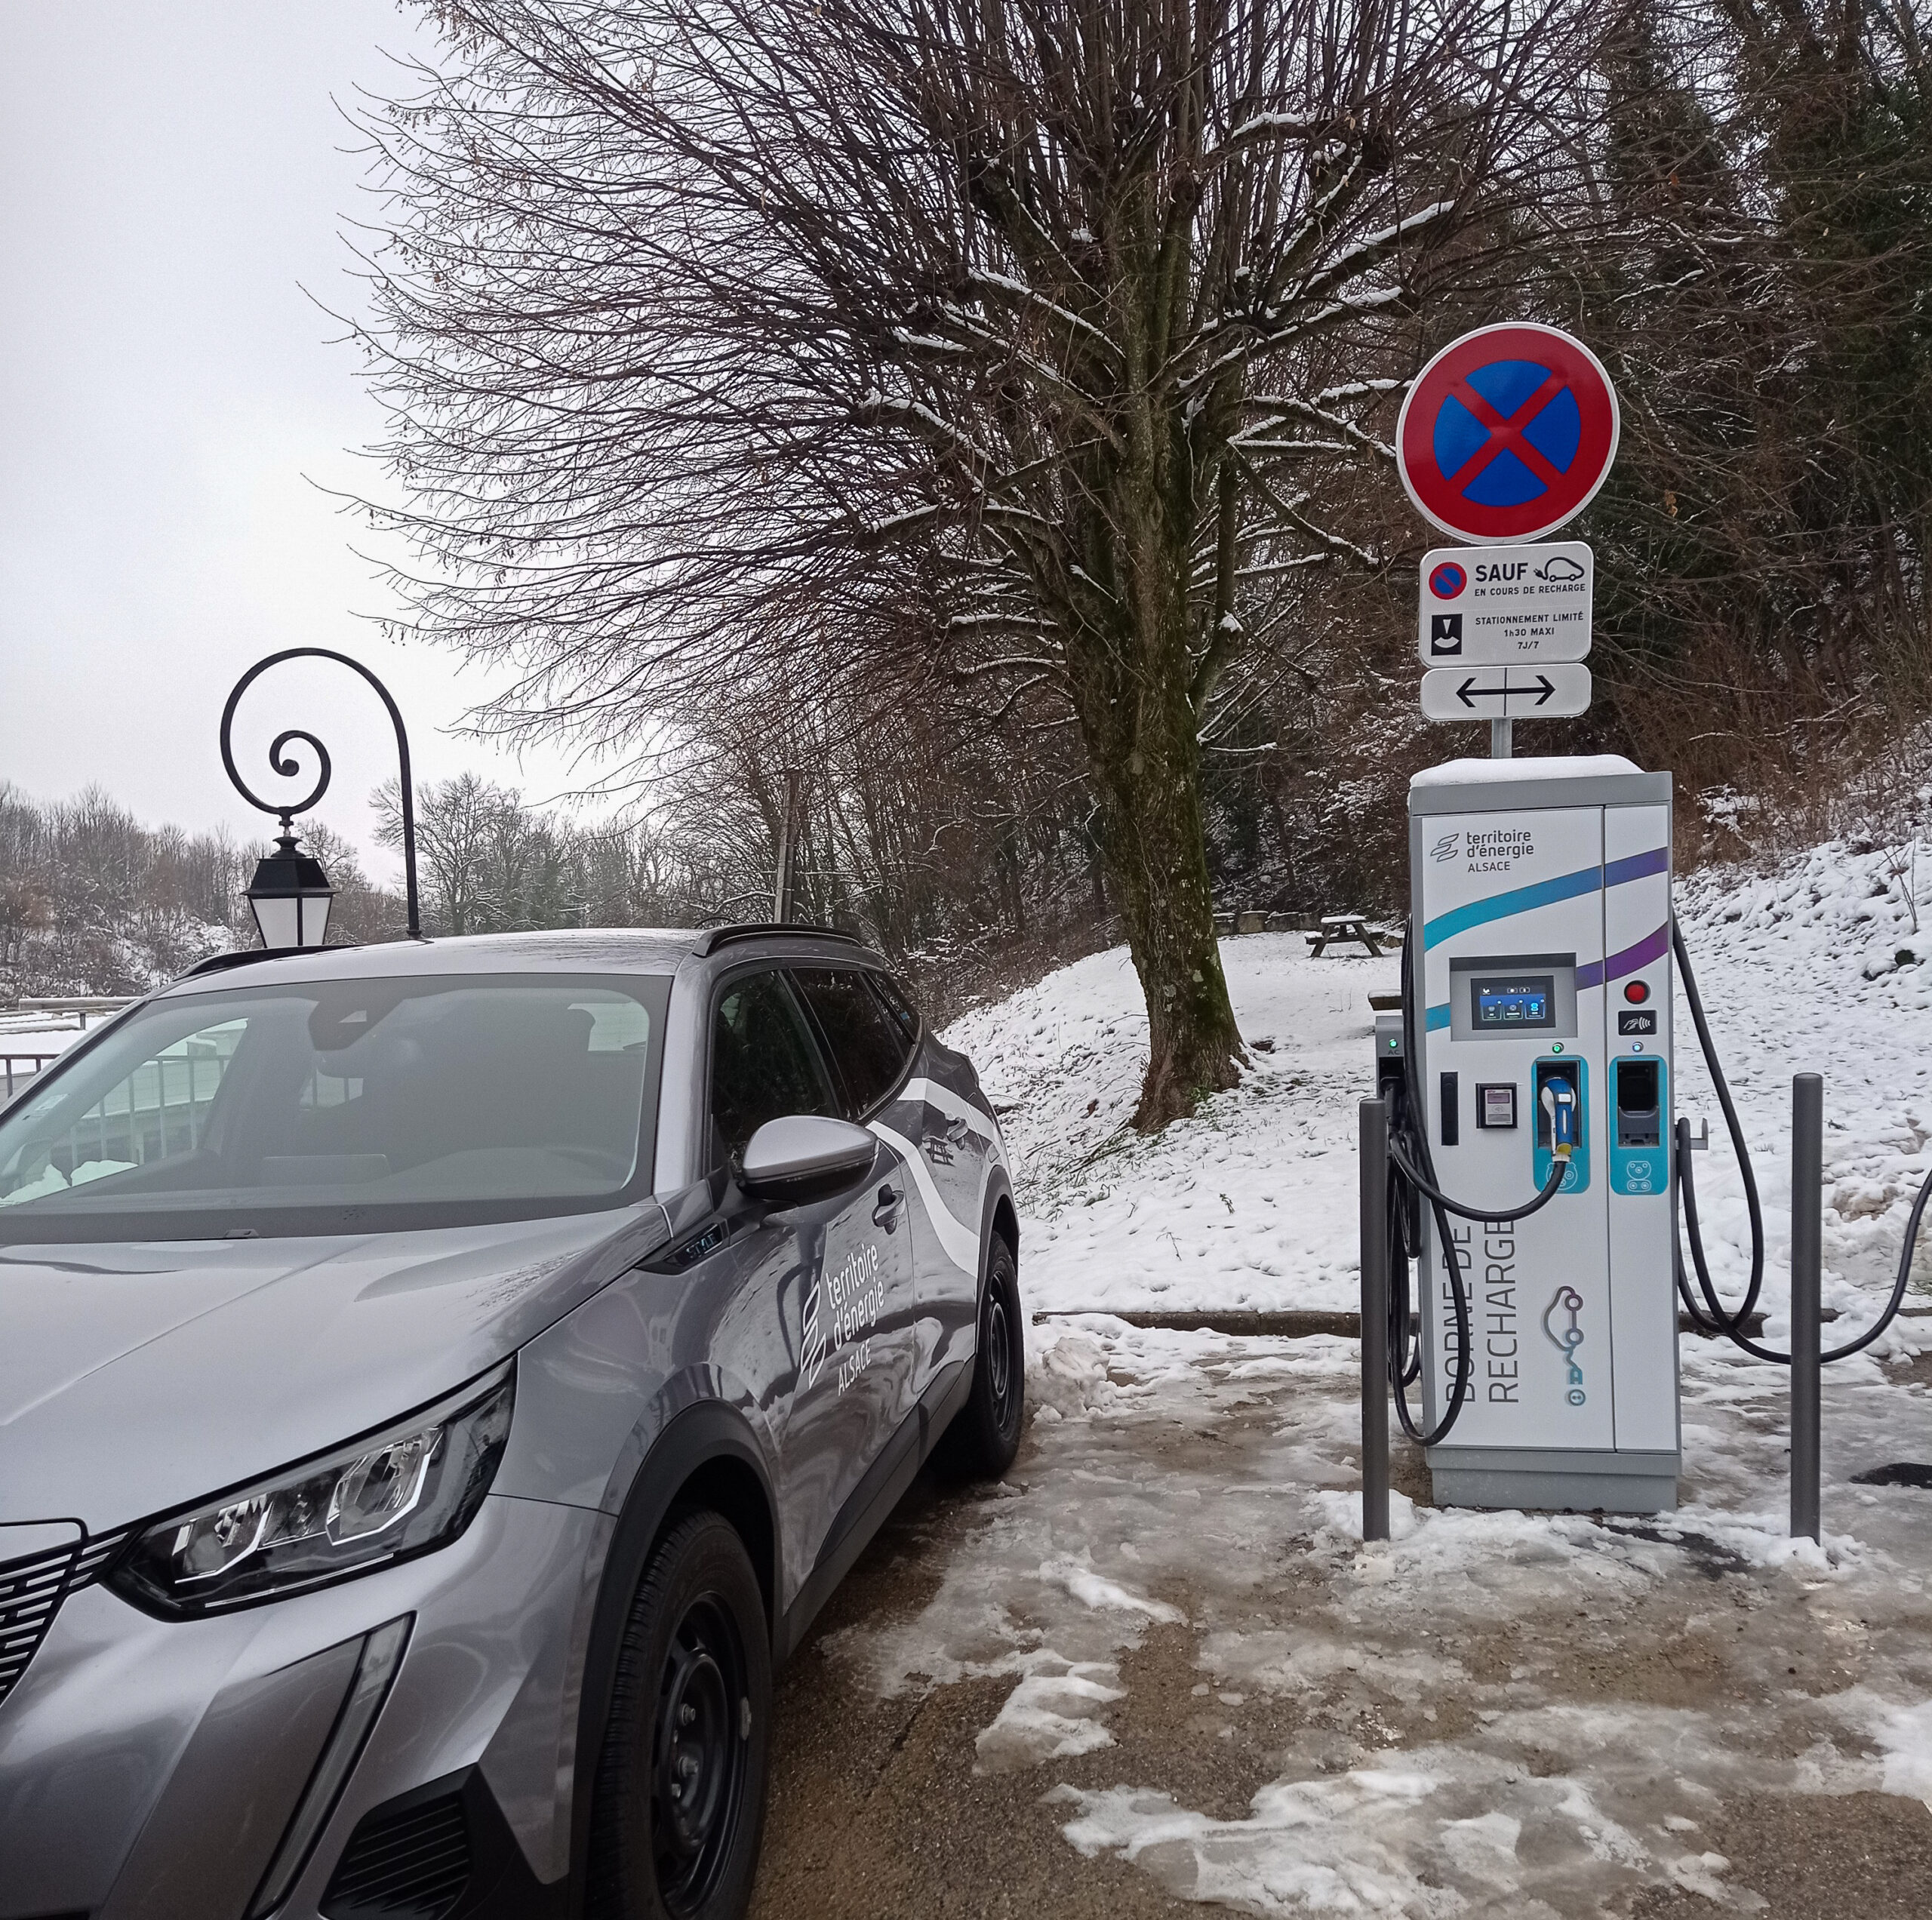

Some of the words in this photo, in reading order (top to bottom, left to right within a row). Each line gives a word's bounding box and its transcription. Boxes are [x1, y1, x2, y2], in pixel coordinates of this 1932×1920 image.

[1475, 562, 1528, 582] SAUF
[1490, 587, 1519, 596] COURS
[1523, 586, 1535, 594] DE
[1539, 583, 1586, 593] RECHARGE
[1475, 614, 1549, 625] STATIONNEMENT
[1553, 611, 1584, 621] LIMITÉ
[1504, 629, 1527, 637] 1h30
[1531, 627, 1555, 635] MAXI
[1518, 642, 1540, 650] 7J/7
[1466, 829, 1531, 845] territoire
[1467, 842, 1534, 859] d'énergie
[1468, 861, 1511, 872] ALSACE
[826, 1243, 878, 1309] territoire
[833, 1276, 884, 1351] d'énergie
[1484, 1220, 1519, 1403] RECHARGE
[838, 1338, 872, 1396] ALSACE
